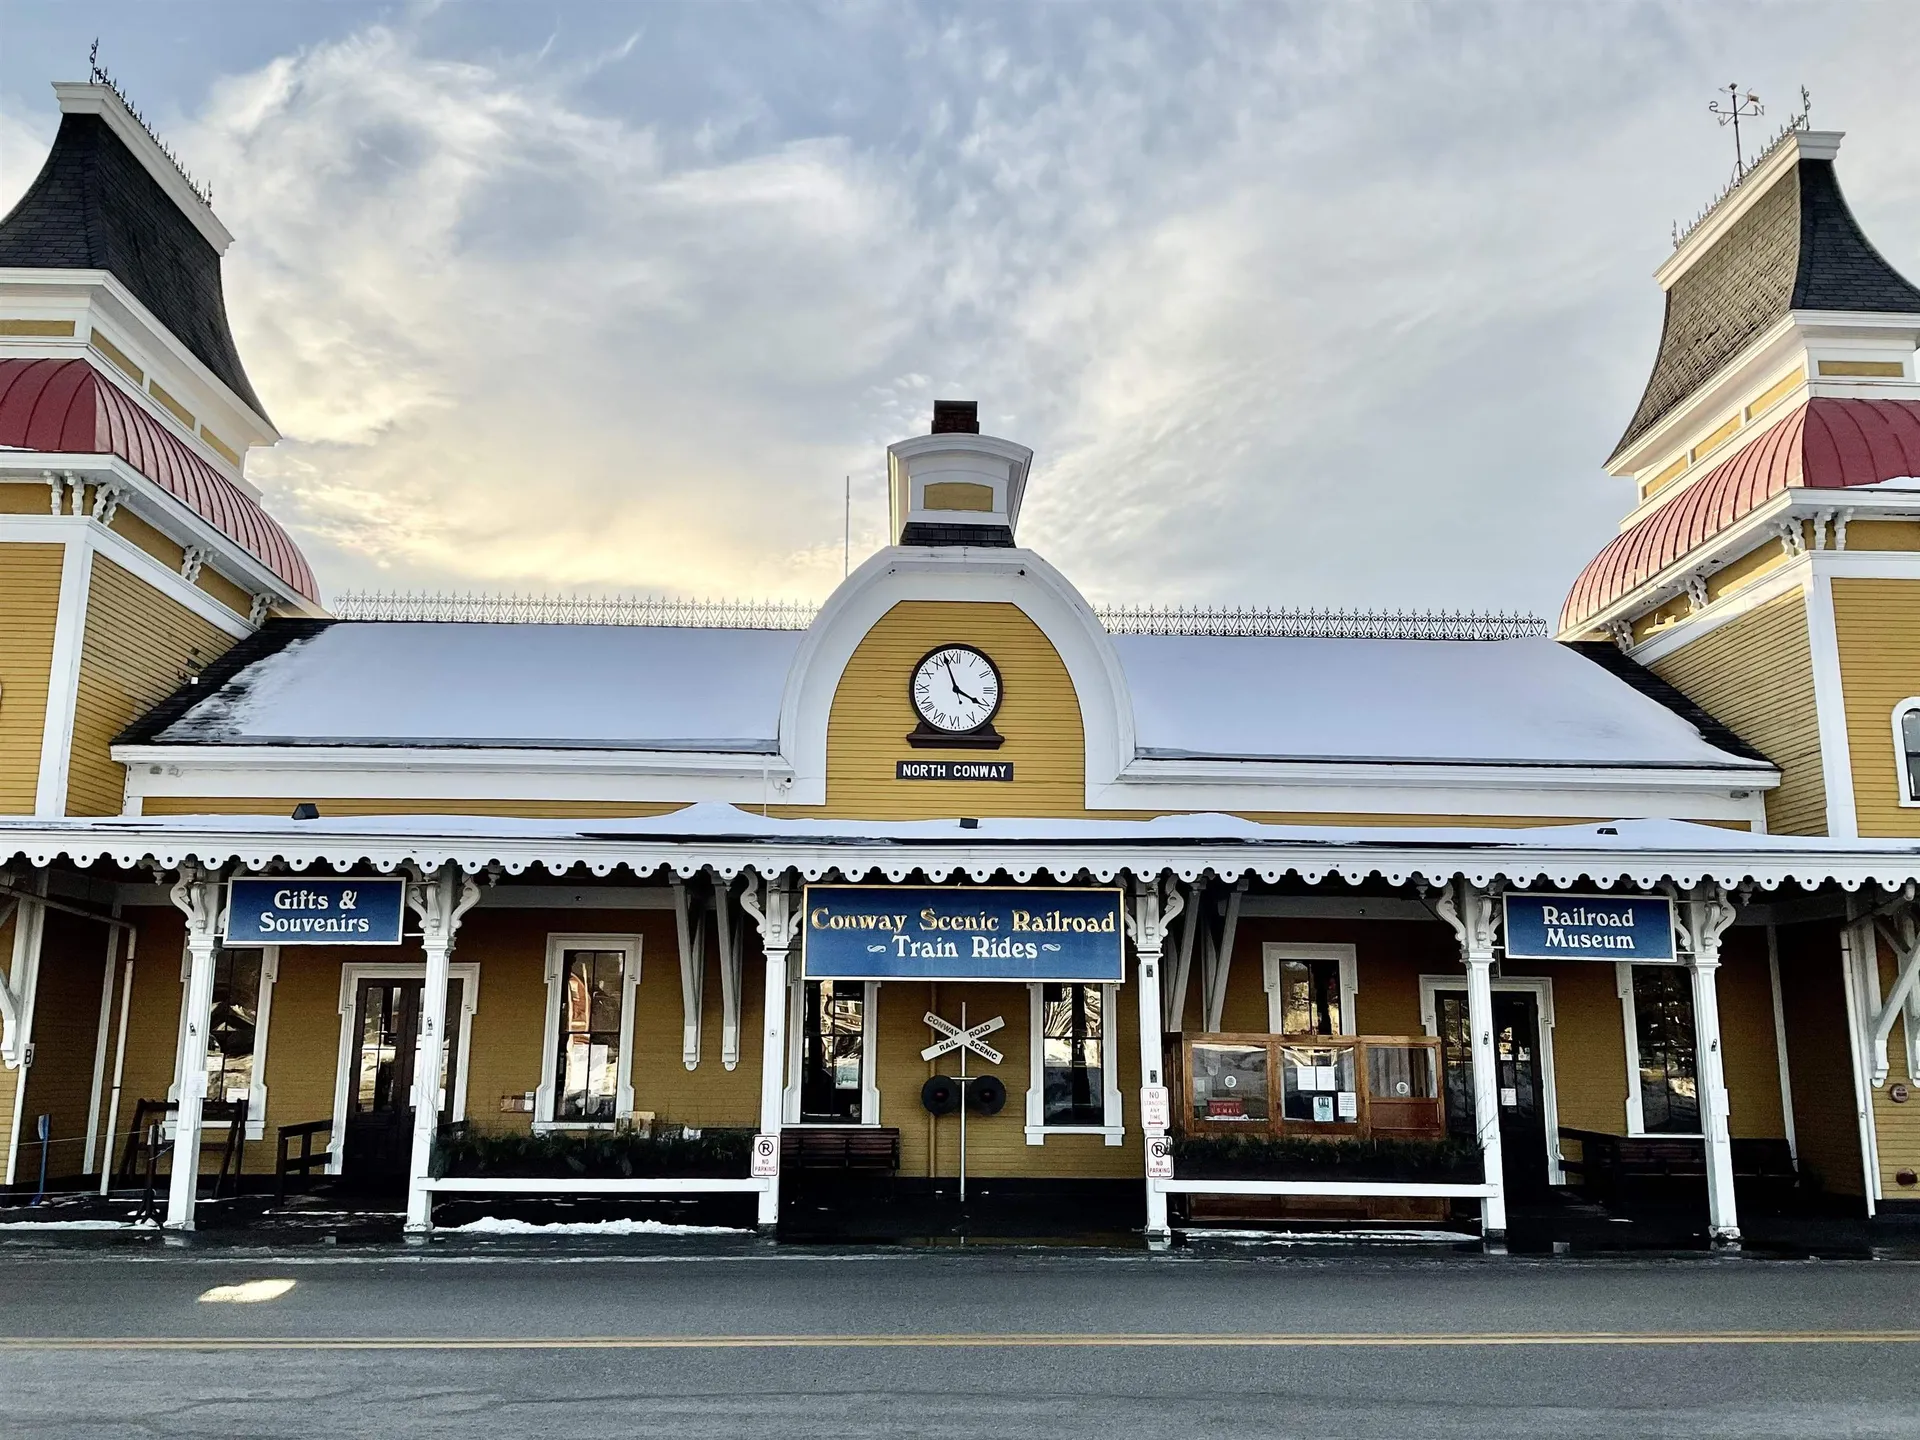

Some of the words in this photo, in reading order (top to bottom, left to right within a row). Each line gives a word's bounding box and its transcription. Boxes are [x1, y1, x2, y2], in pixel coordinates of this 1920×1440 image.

[902, 764, 946, 777] NORTH
[953, 764, 1007, 778] CONWAY
[274, 889, 328, 910] Gifts
[339, 889, 357, 910] &
[259, 911, 369, 932] Souvenirs
[811, 907, 907, 934] Conway
[919, 908, 999, 931] Scenic
[1011, 909, 1115, 933] Railroad
[1542, 905, 1634, 927] Railroad
[892, 934, 958, 958] Train
[971, 936, 1038, 959] Rides
[1545, 928, 1635, 949] Museum
[927, 1015, 960, 1037] CONWAY
[968, 1024, 991, 1039] ROAD
[939, 1039, 958, 1051] RAIL
[969, 1040, 998, 1060] SCENIC
[25, 1048, 32, 1065] B
[1149, 1091, 1160, 1099] NO
